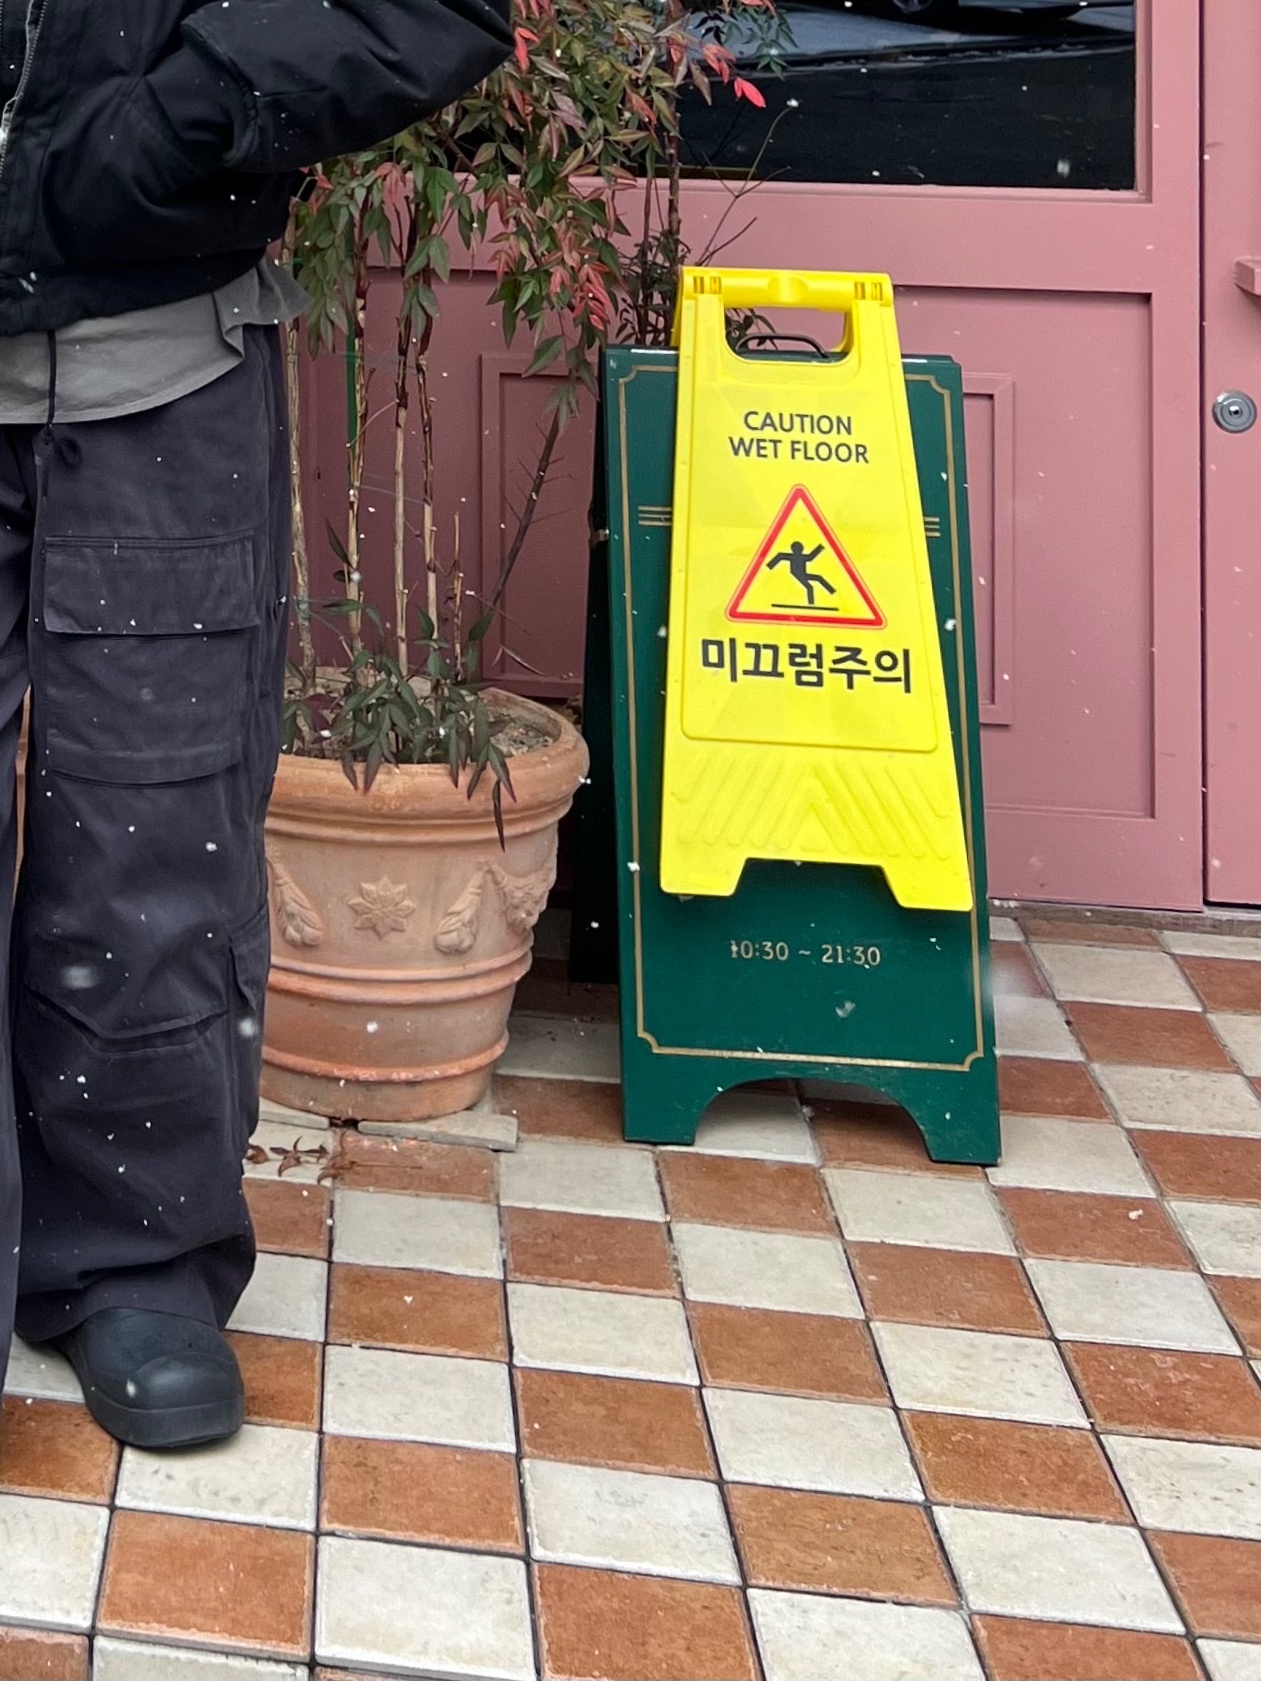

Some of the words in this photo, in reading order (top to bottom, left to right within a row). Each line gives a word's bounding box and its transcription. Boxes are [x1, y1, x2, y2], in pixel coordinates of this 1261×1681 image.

[743, 411, 852, 435] CAUTION
[728, 436, 782, 459] WET
[790, 440, 869, 463] FLOOR
[701, 637, 911, 694] 미끄럼주의
[730, 940, 789, 961] 10:30
[821, 944, 881, 966] 21:30
